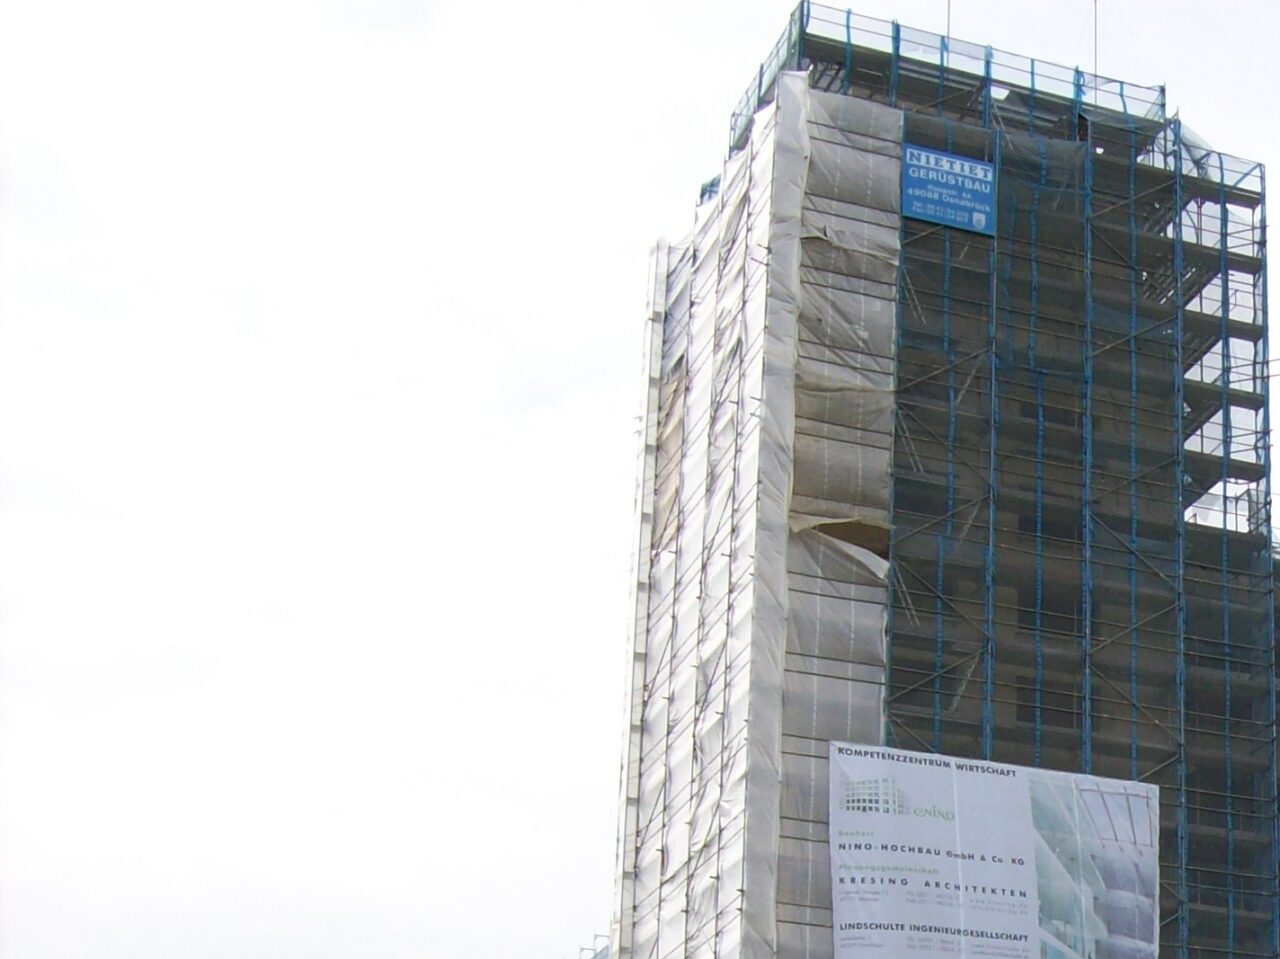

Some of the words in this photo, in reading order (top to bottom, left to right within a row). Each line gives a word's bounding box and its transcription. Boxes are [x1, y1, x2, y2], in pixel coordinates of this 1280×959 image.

[909, 167, 990, 193] GERÜSTBAU
[838, 747, 951, 769] KOMPETENZZENTRUM
[955, 762, 1017, 778] WIRTSCHAFT
[946, 850, 975, 861] GmbH
[1011, 857, 1025, 866] KG
[839, 877, 909, 886] KRESING
[924, 880, 1027, 898] ARCHITEKTEN
[839, 922, 905, 931] LINDSCHULTE
[909, 924, 1029, 942] INGENIEURGESELLSCHAFT
